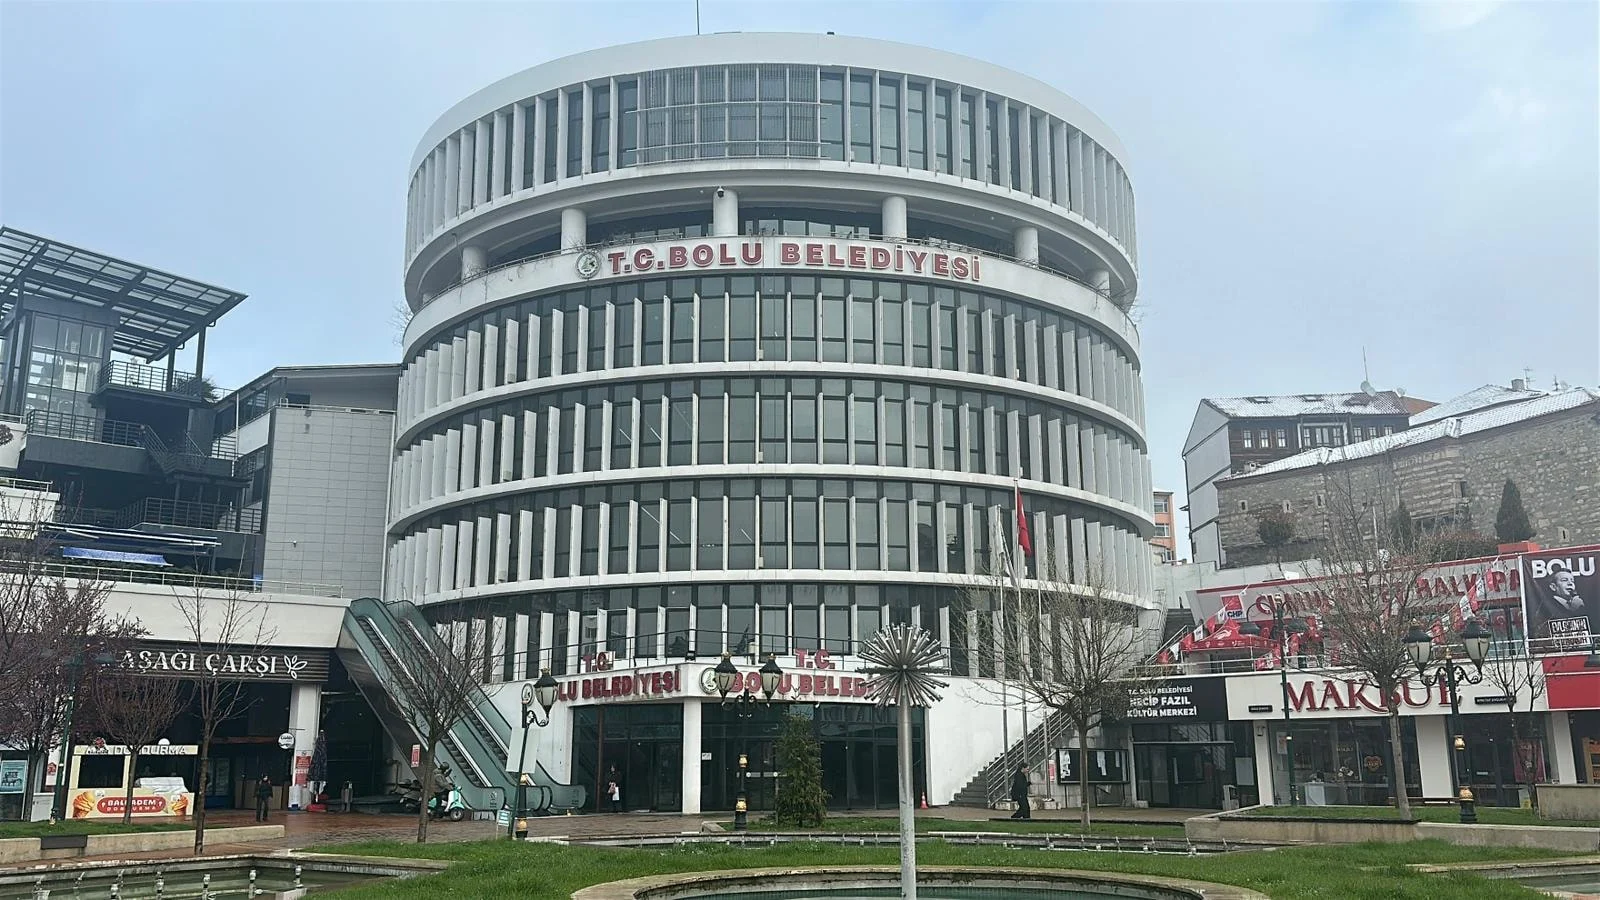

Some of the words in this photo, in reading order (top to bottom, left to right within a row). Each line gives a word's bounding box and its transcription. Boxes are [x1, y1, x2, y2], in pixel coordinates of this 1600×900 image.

[780, 242, 980, 280] BELEDİYESİ
[1531, 557, 1595, 578] BOLU
[1227, 610, 1243, 618] CHP
[118, 648, 196, 673] AŞAĞI
[205, 653, 277, 677] ÇARŞI
[794, 649, 835, 669] T.C.
[557, 680, 578, 702] LU
[582, 666, 680, 699] BELEDİYESİ
[730, 671, 792, 695] BOU
[799, 674, 872, 698] BELED
[1157, 685, 1193, 694] BELEDİYESİ
[1161, 696, 1191, 705] FAZIL
[1127, 707, 1158, 718] KÜLTÜR
[1160, 705, 1197, 717] MERKEZİ
[107, 799, 157, 807] BALADEM
